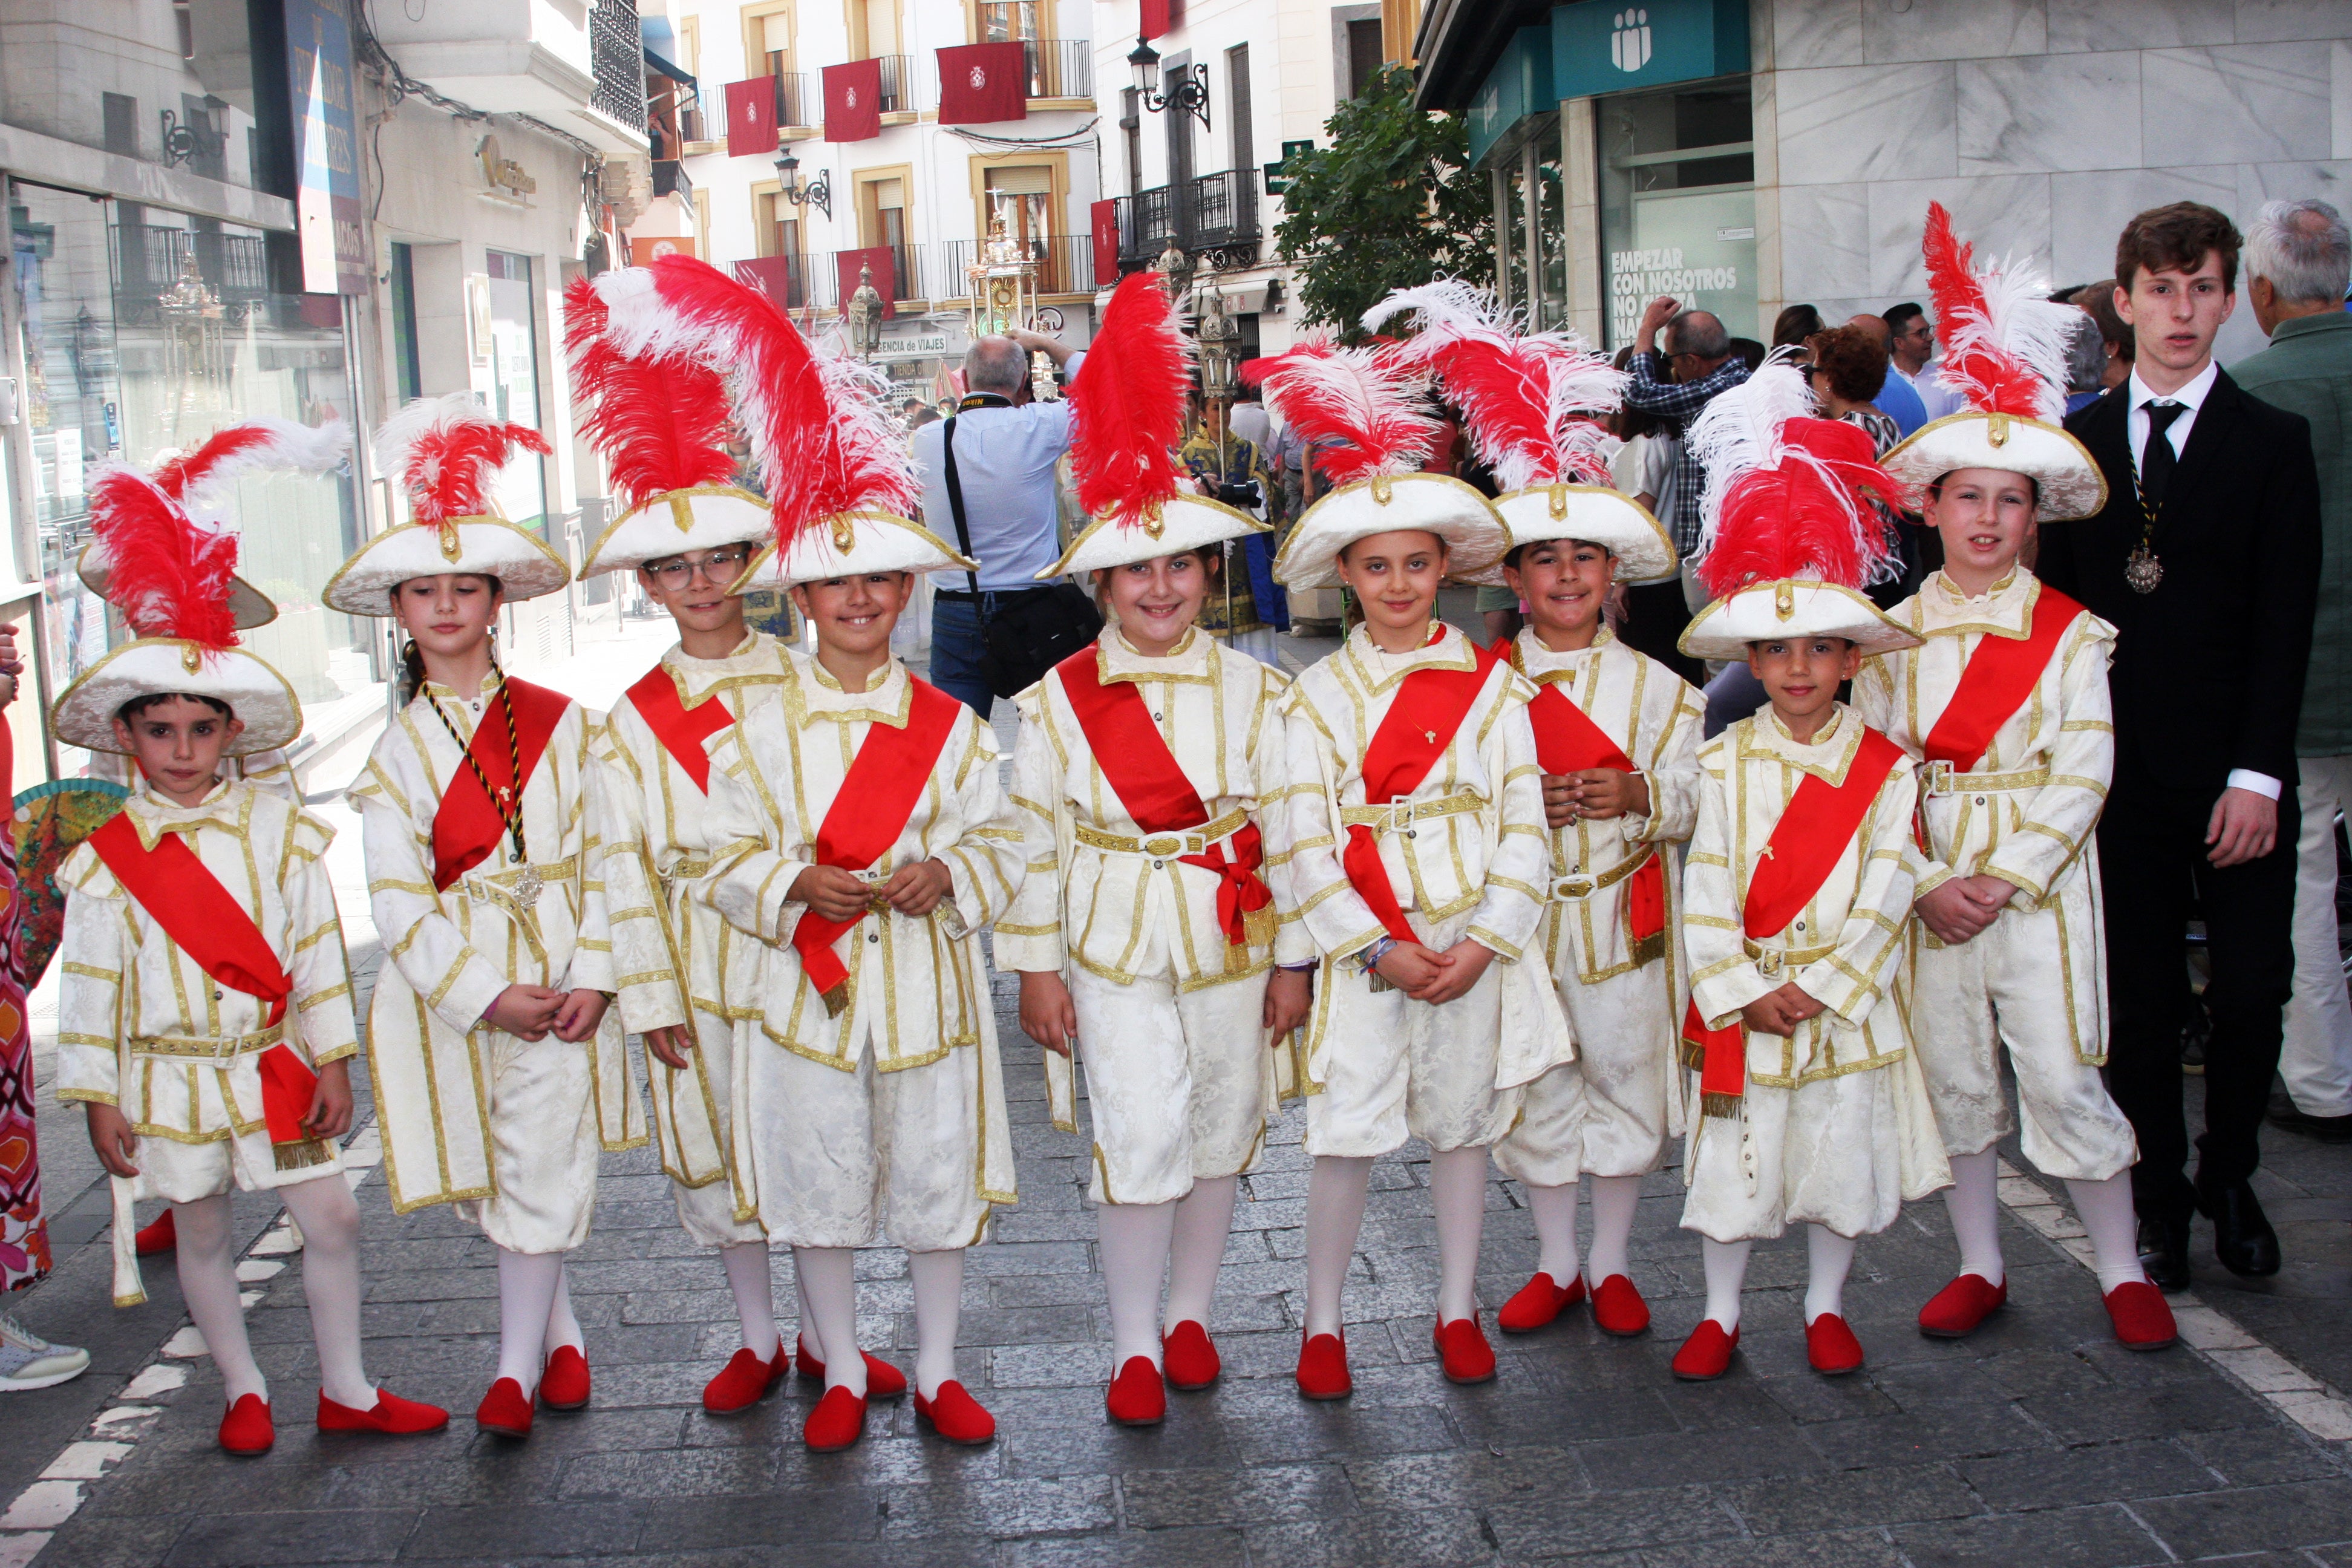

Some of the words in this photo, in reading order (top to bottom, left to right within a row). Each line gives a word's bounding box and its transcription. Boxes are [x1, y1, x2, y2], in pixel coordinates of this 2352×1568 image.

[1612, 247, 1684, 273] EMPEZAR
[1612, 272, 1645, 295] CON
[1649, 267, 1737, 293] NOSOTROS
[1613, 295, 1637, 317] NO
[1641, 292, 1697, 311] CTA
[878, 341, 904, 353] GENCIA
[907, 340, 916, 351] de
[918, 338, 945, 350] VIAJES
[893, 364, 916, 376] TIENDA
